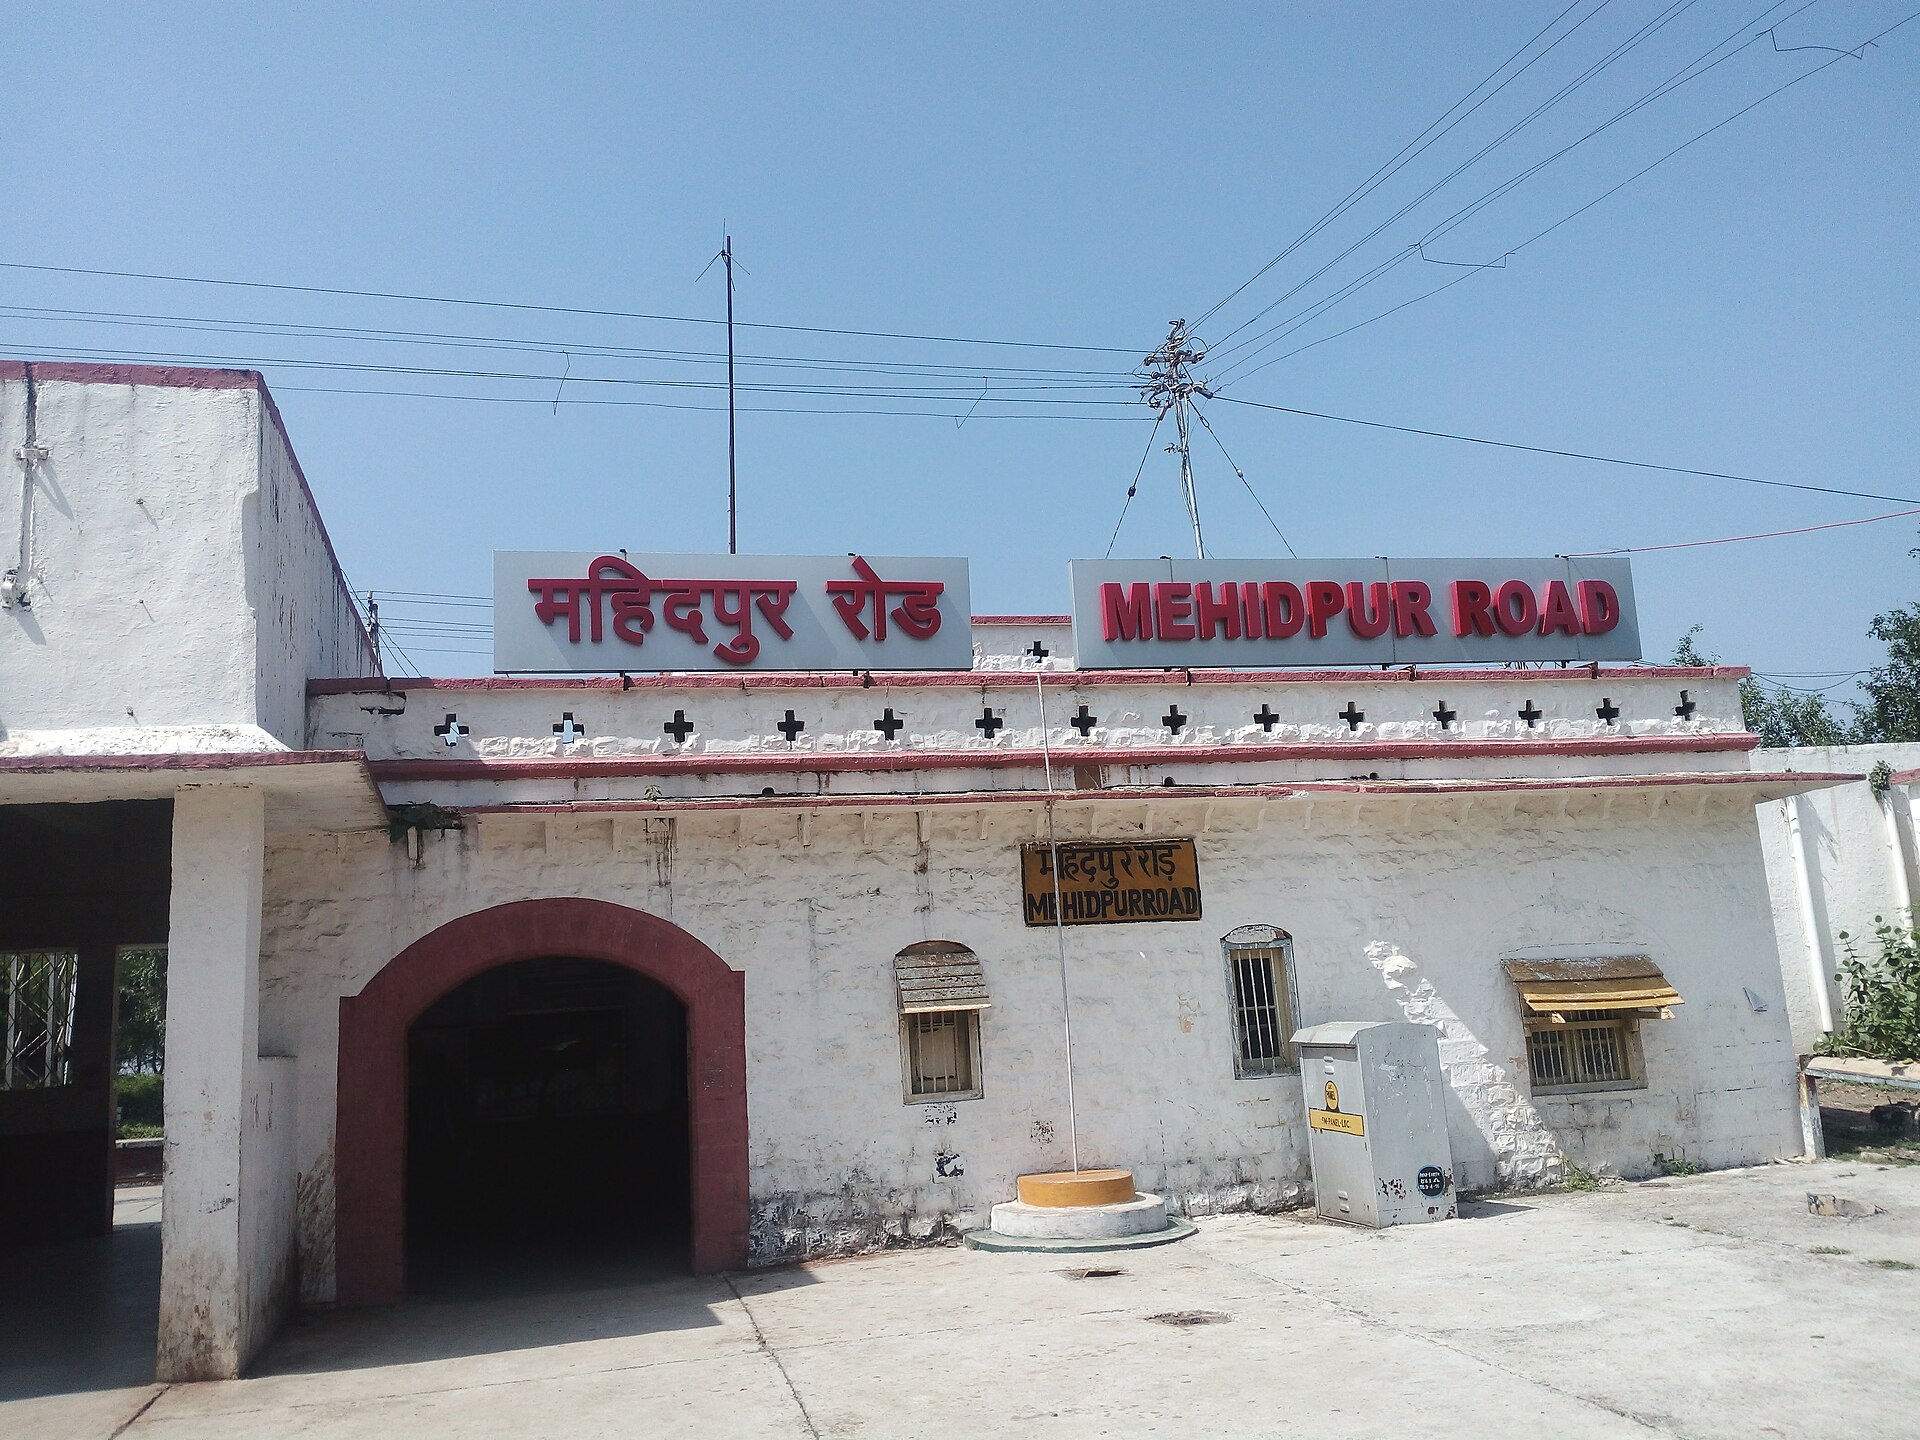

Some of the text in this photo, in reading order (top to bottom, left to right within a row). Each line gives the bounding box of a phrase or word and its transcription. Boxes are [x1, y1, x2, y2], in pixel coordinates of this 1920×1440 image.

[527, 554, 945, 665] महिदपुर रोड
[1099, 578, 1621, 642] MEHIDPUR ROAD
